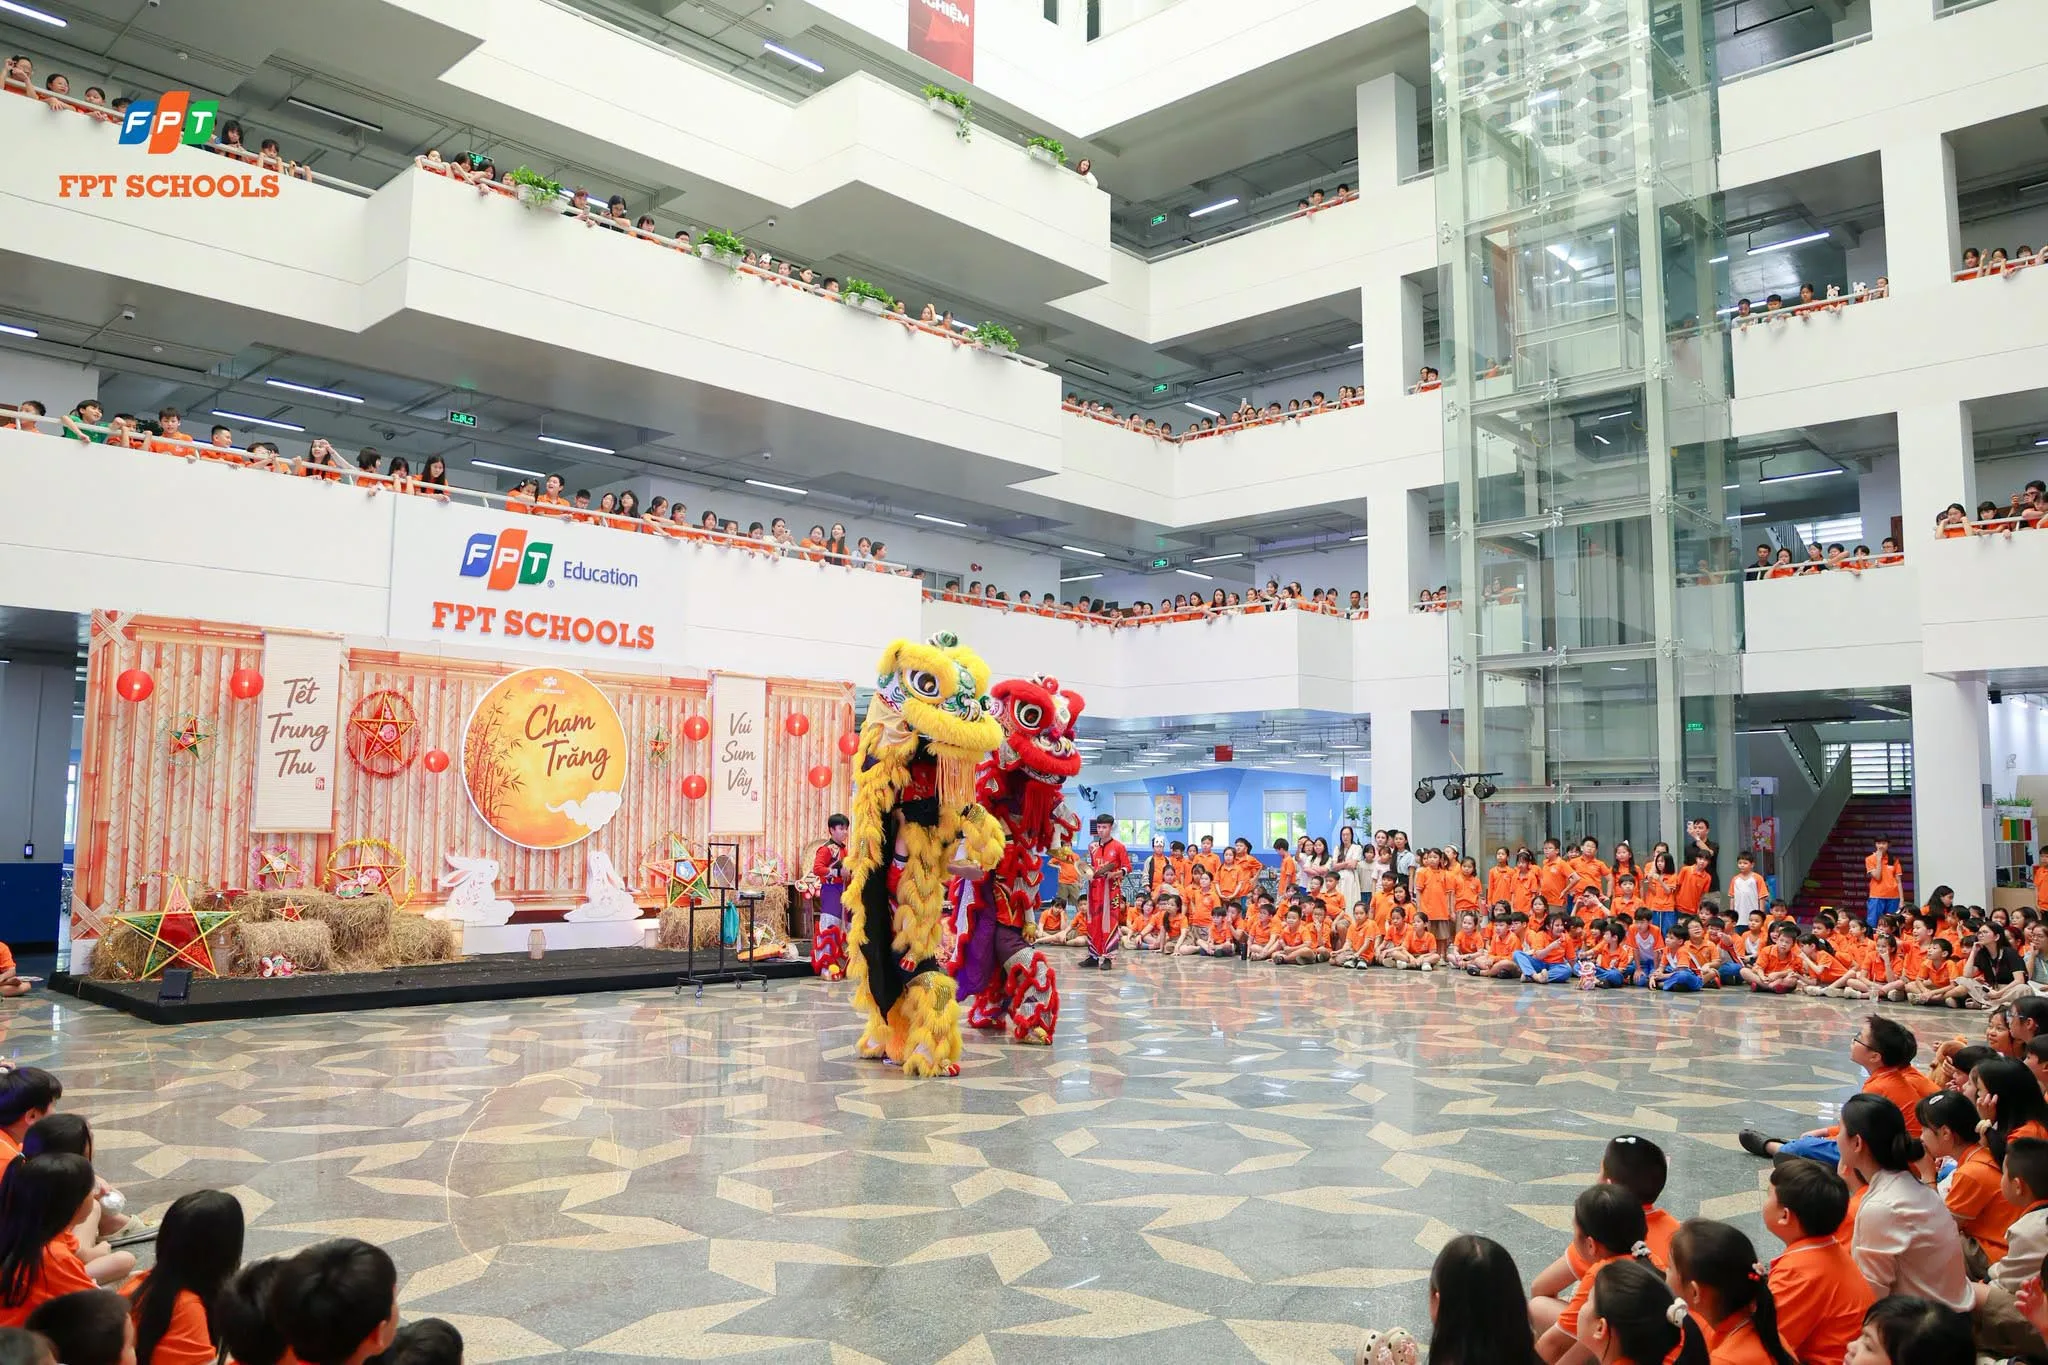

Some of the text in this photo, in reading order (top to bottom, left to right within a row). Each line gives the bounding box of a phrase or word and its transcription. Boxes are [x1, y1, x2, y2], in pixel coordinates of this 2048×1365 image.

[920, 0, 970, 28] GHIỆM
[563, 560, 638, 588] Education
[432, 601, 655, 650] FPT SCHOOLS
[283, 677, 321, 709] Tết
[267, 712, 331, 752] Trung
[524, 703, 596, 741] Chạm
[729, 711, 753, 737] Vui
[275, 749, 316, 778] Thu
[542, 739, 611, 781] Trăng
[721, 740, 756, 763] Sum
[727, 767, 753, 796] Vầy
